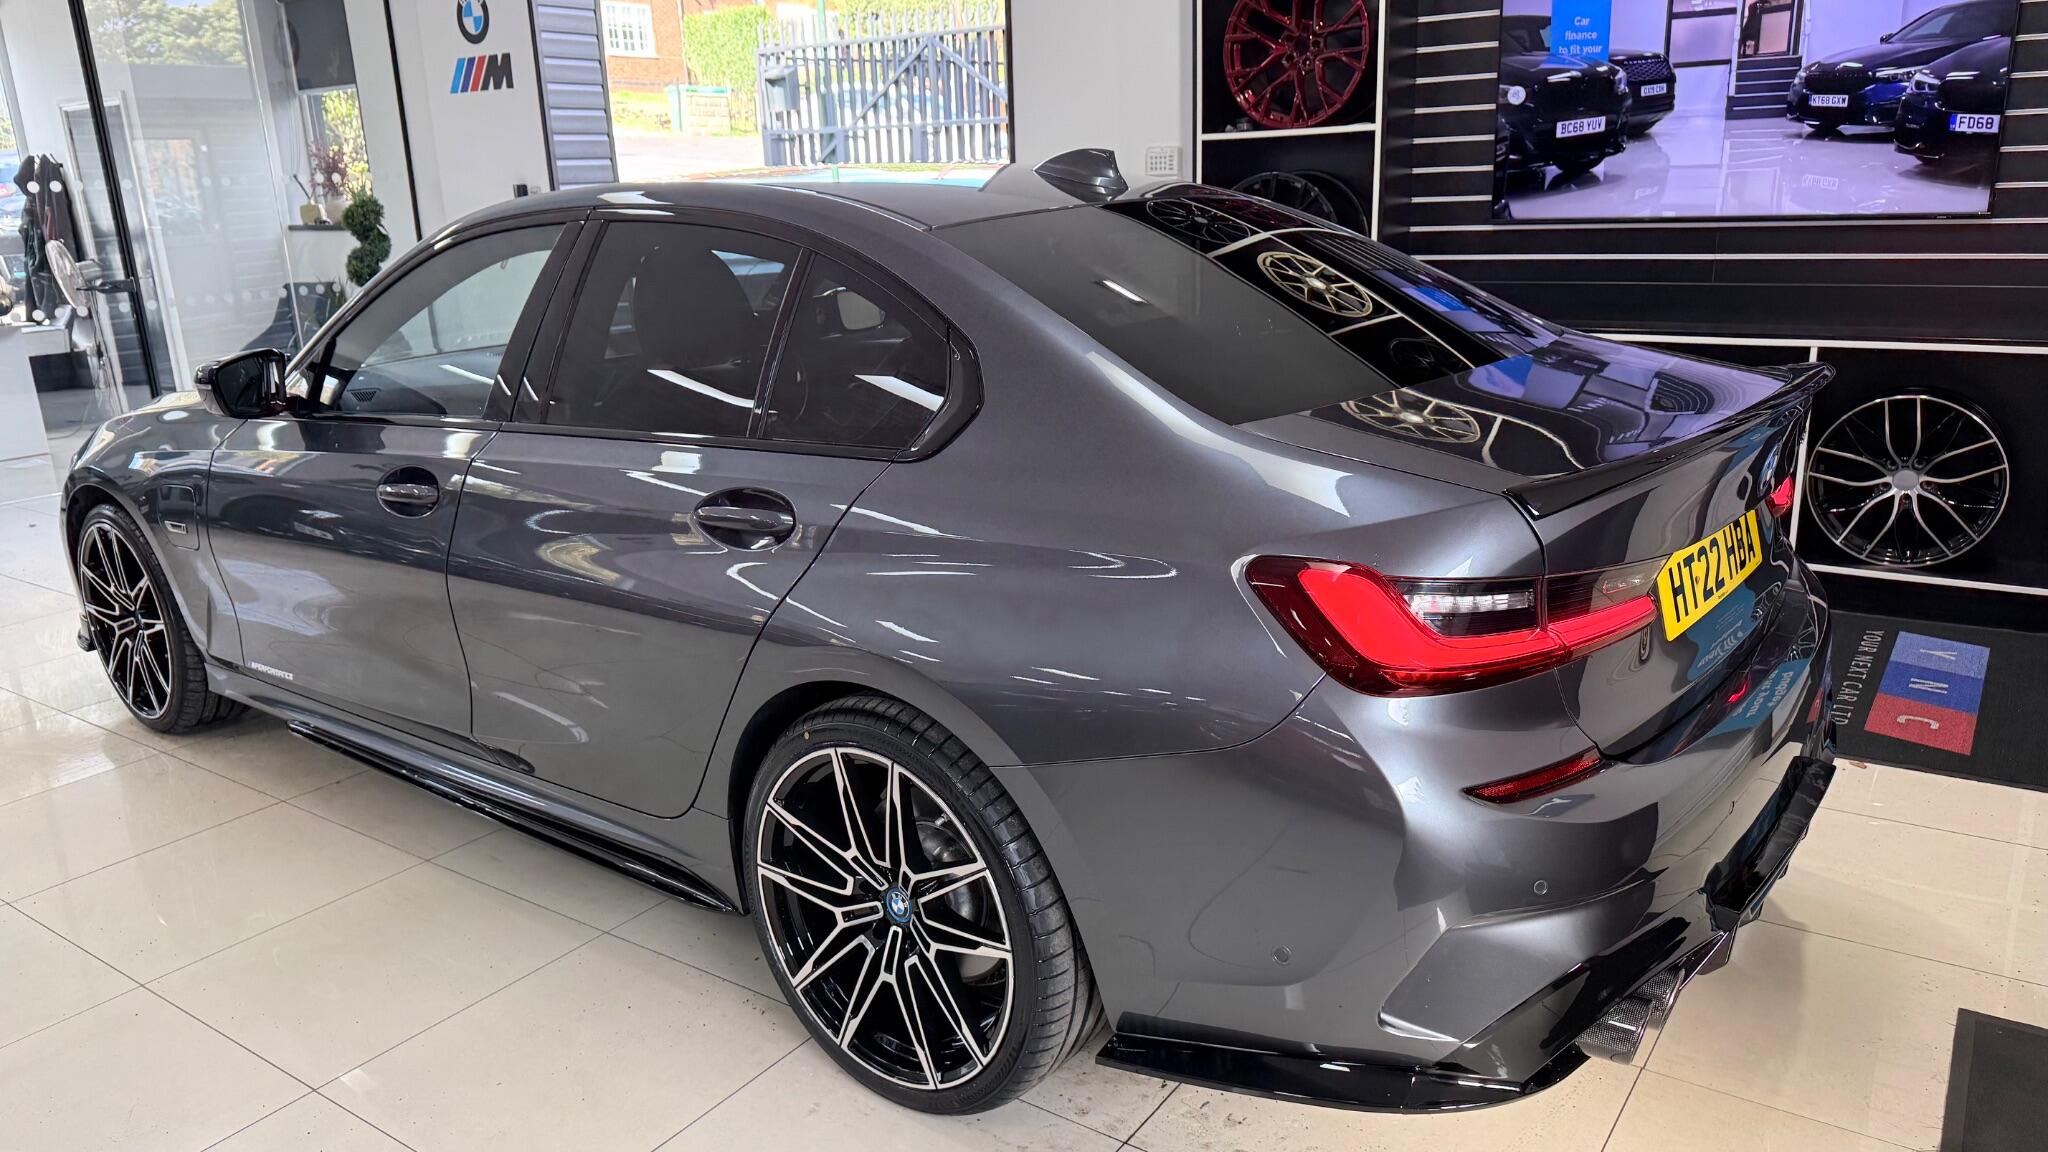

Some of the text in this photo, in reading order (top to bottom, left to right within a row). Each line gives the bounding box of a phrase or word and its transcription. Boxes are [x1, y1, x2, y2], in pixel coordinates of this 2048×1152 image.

[1574, 16, 1590, 26] Car
[1565, 30, 1597, 40] finance
[1570, 45, 1581, 54] fit
[1583, 44, 1603, 55] your
[1812, 95, 1847, 105] KT68 GXW
[1560, 118, 1604, 135] BC68 YUV
[1957, 115, 1995, 130] FD68
[1668, 513, 1756, 623] HT22 HBA
[1831, 630, 1885, 725] YOUR NEXT CAR LTD
[1897, 648, 1958, 730] Y N C
